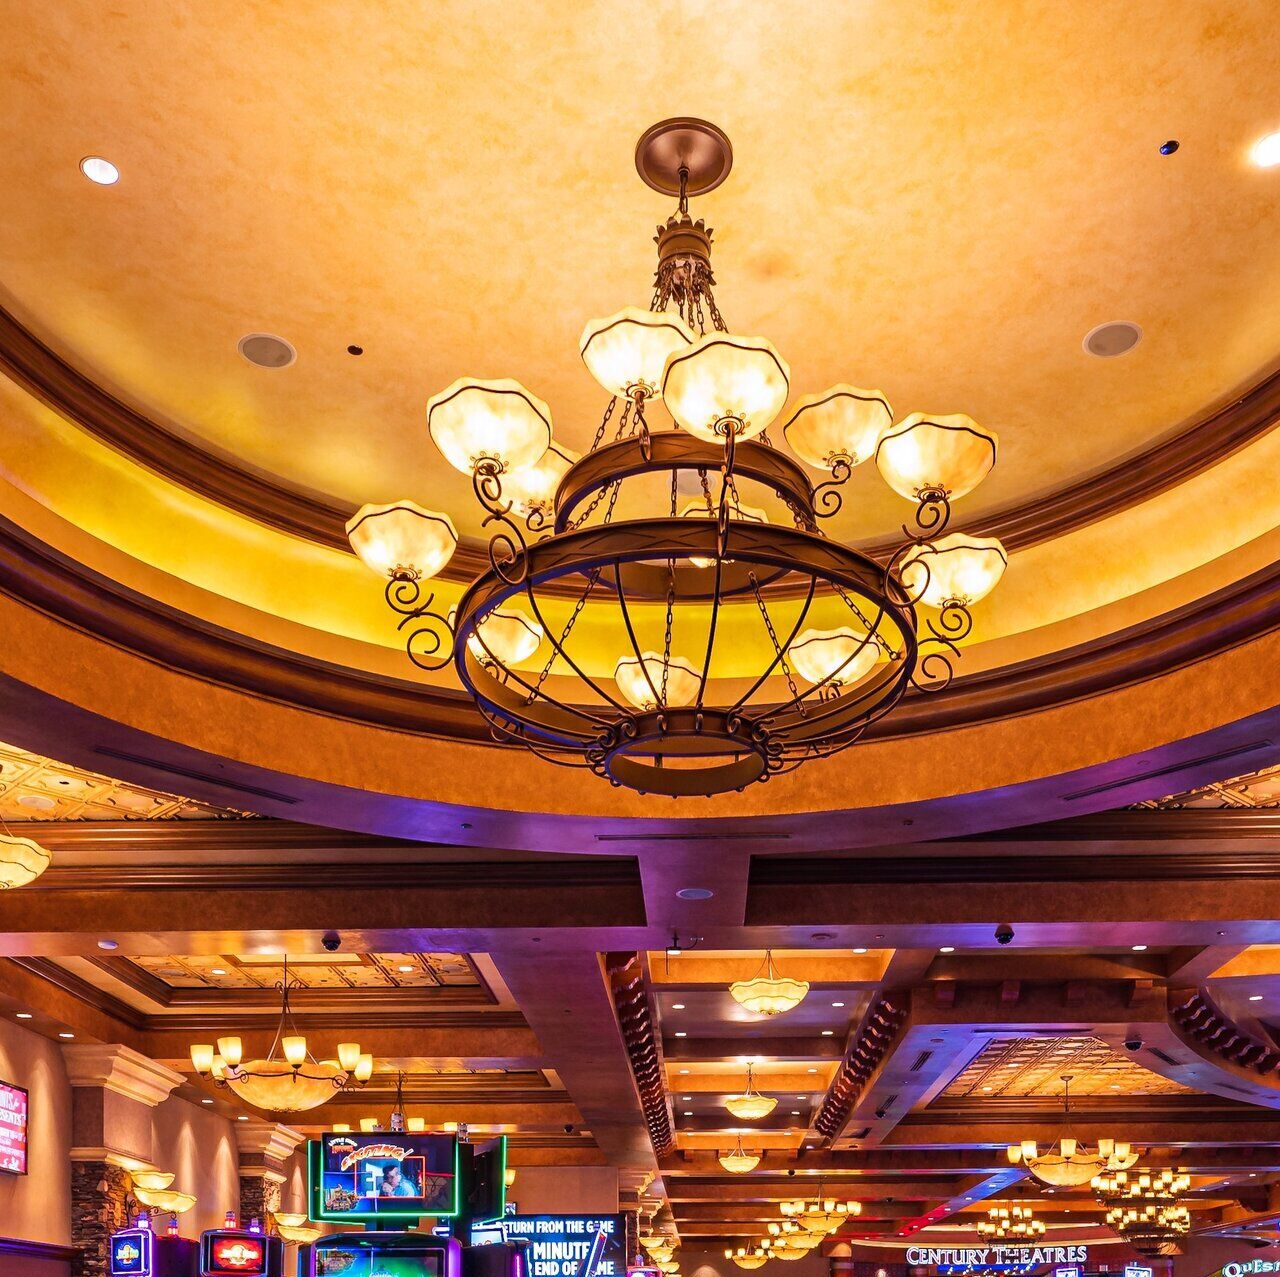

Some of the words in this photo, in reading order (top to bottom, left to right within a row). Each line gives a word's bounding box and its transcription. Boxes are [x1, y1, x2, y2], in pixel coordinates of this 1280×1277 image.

[536, 1221, 565, 1233] FROM
[566, 1221, 584, 1233] THE
[586, 1221, 614, 1233] GME
[906, 1246, 989, 1266] CENTURY
[992, 1245, 1087, 1265] THEATRES
[534, 1262, 559, 1276] END
[562, 1262, 577, 1275] OF
